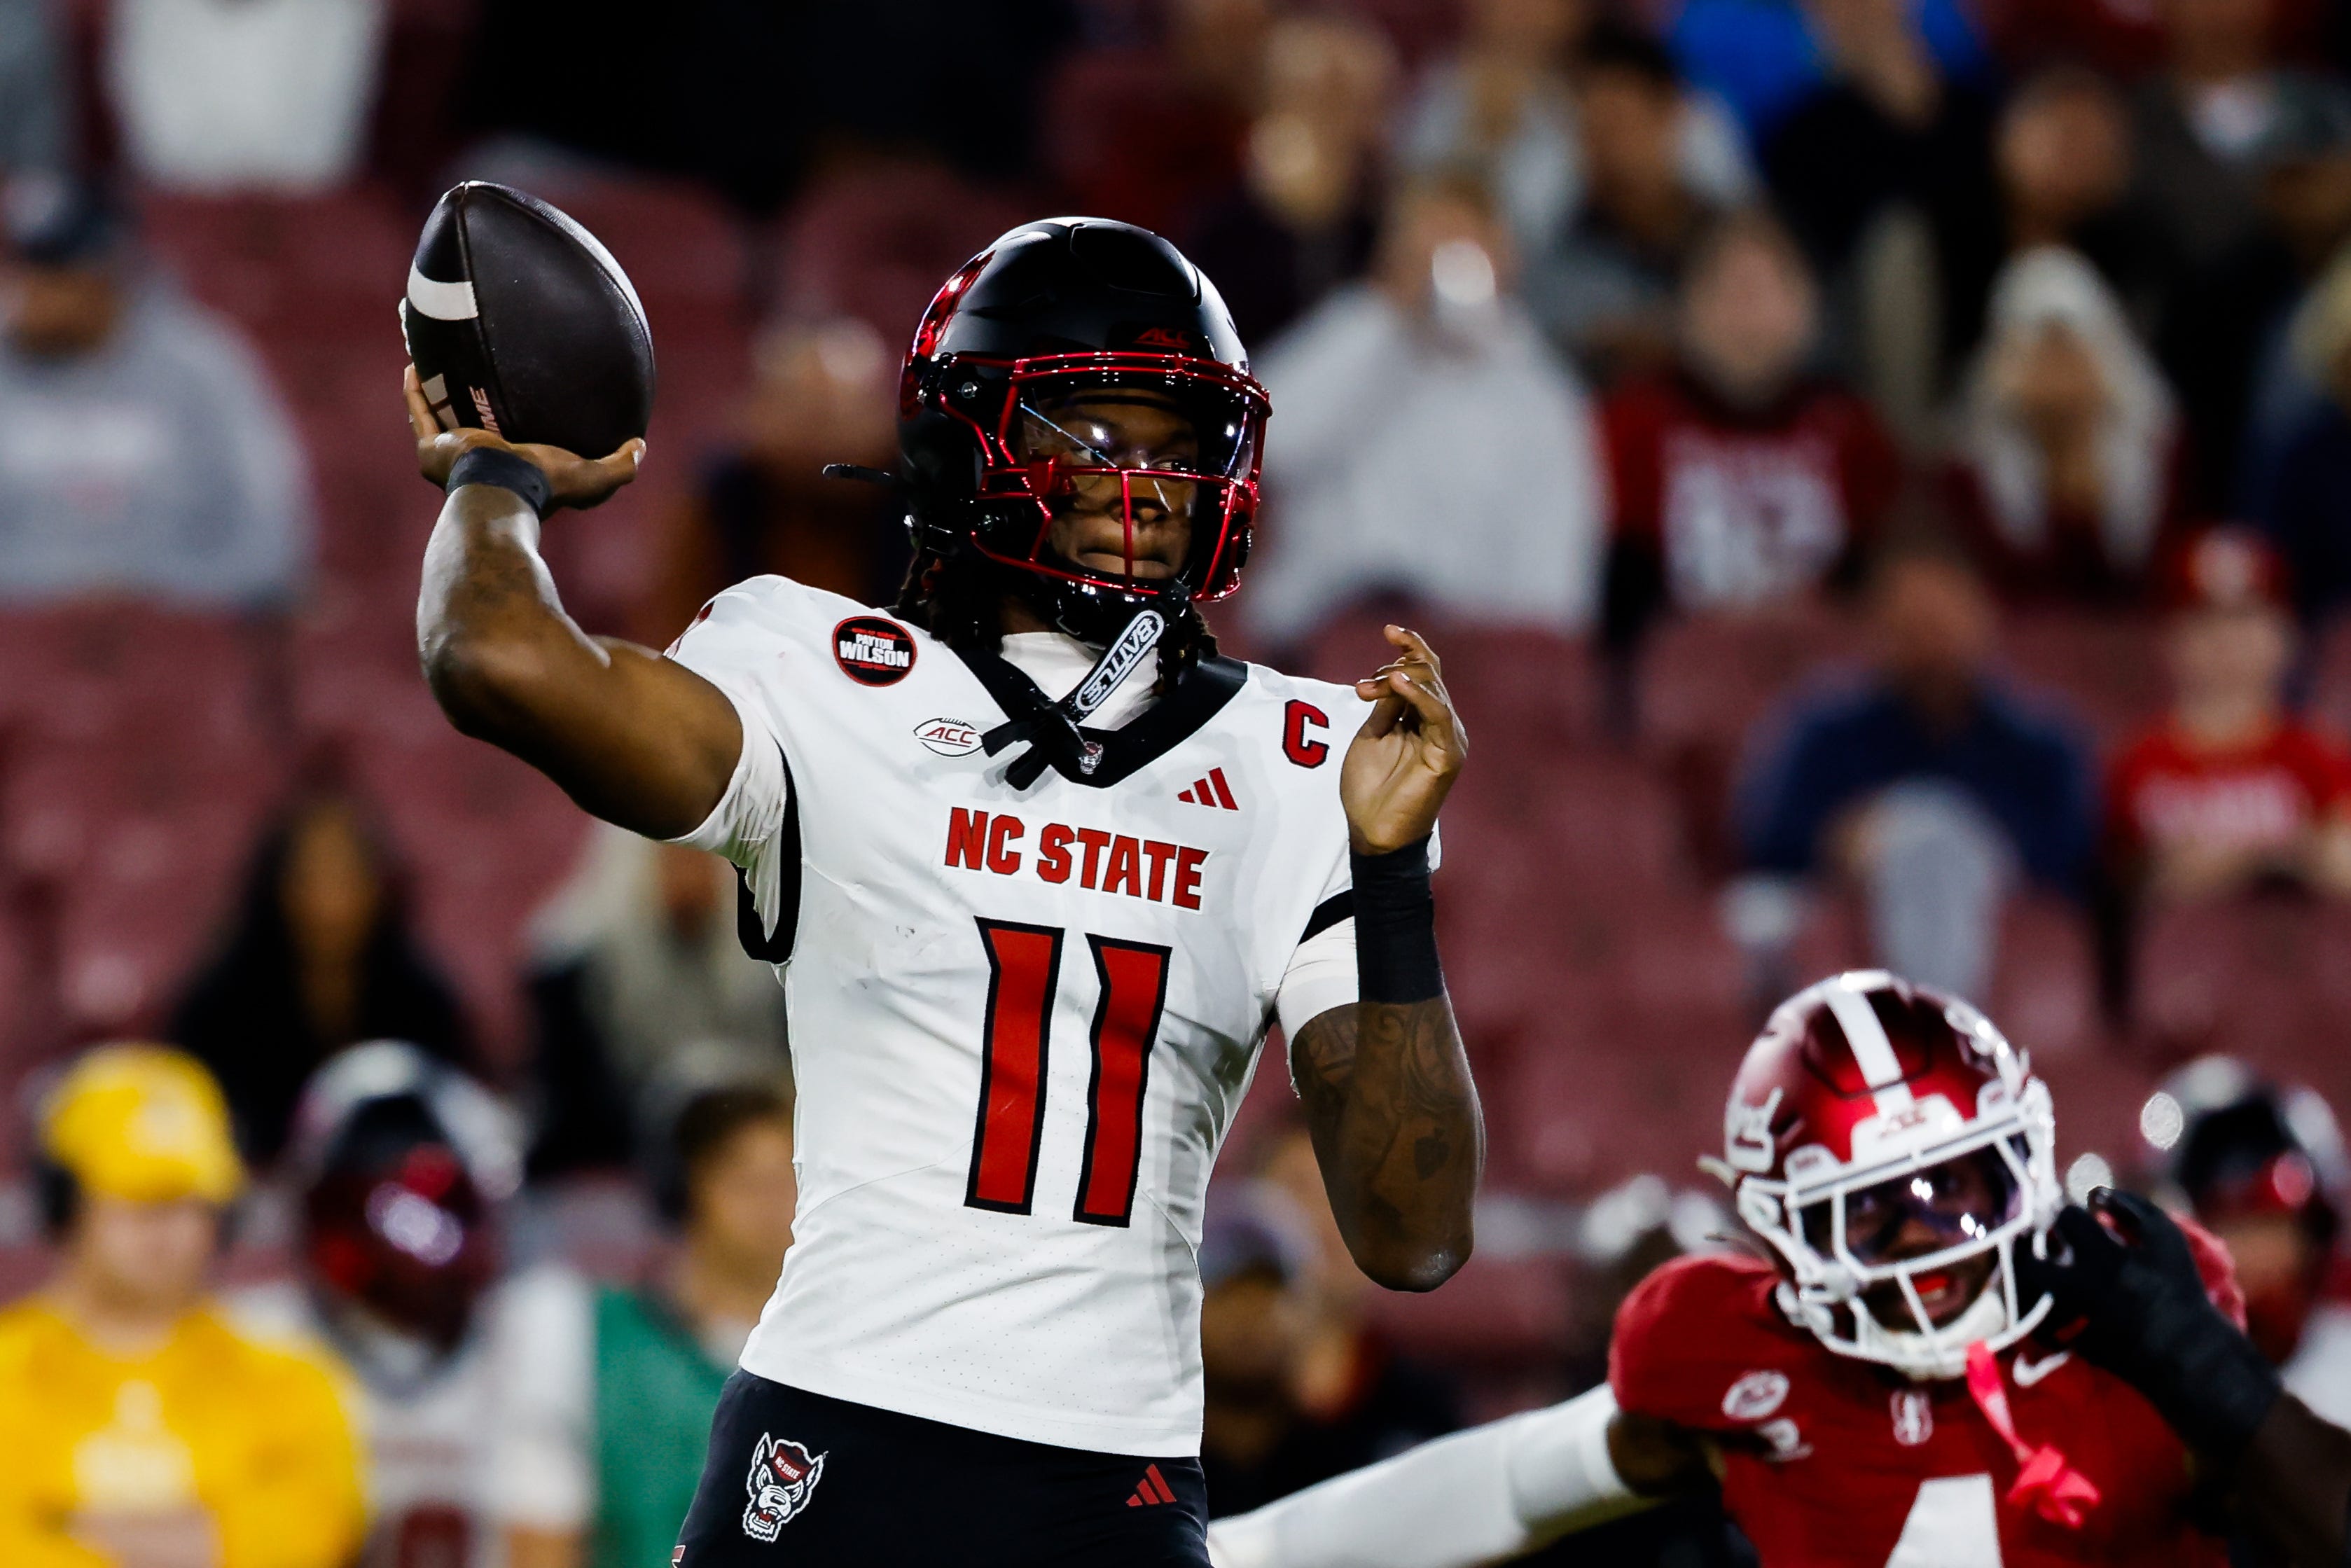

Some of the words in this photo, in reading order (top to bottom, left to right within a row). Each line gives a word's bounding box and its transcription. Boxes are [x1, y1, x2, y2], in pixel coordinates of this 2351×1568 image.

[839, 639, 910, 667] WILSON
[855, 632, 895, 651] PAYTON
[924, 726, 978, 744] ACC
[1282, 699, 1329, 769] C
[944, 806, 1025, 876] NC
[1036, 822, 1209, 910] STATE
[963, 915, 1173, 1228] 11
[781, 1464, 800, 1479] STATE
